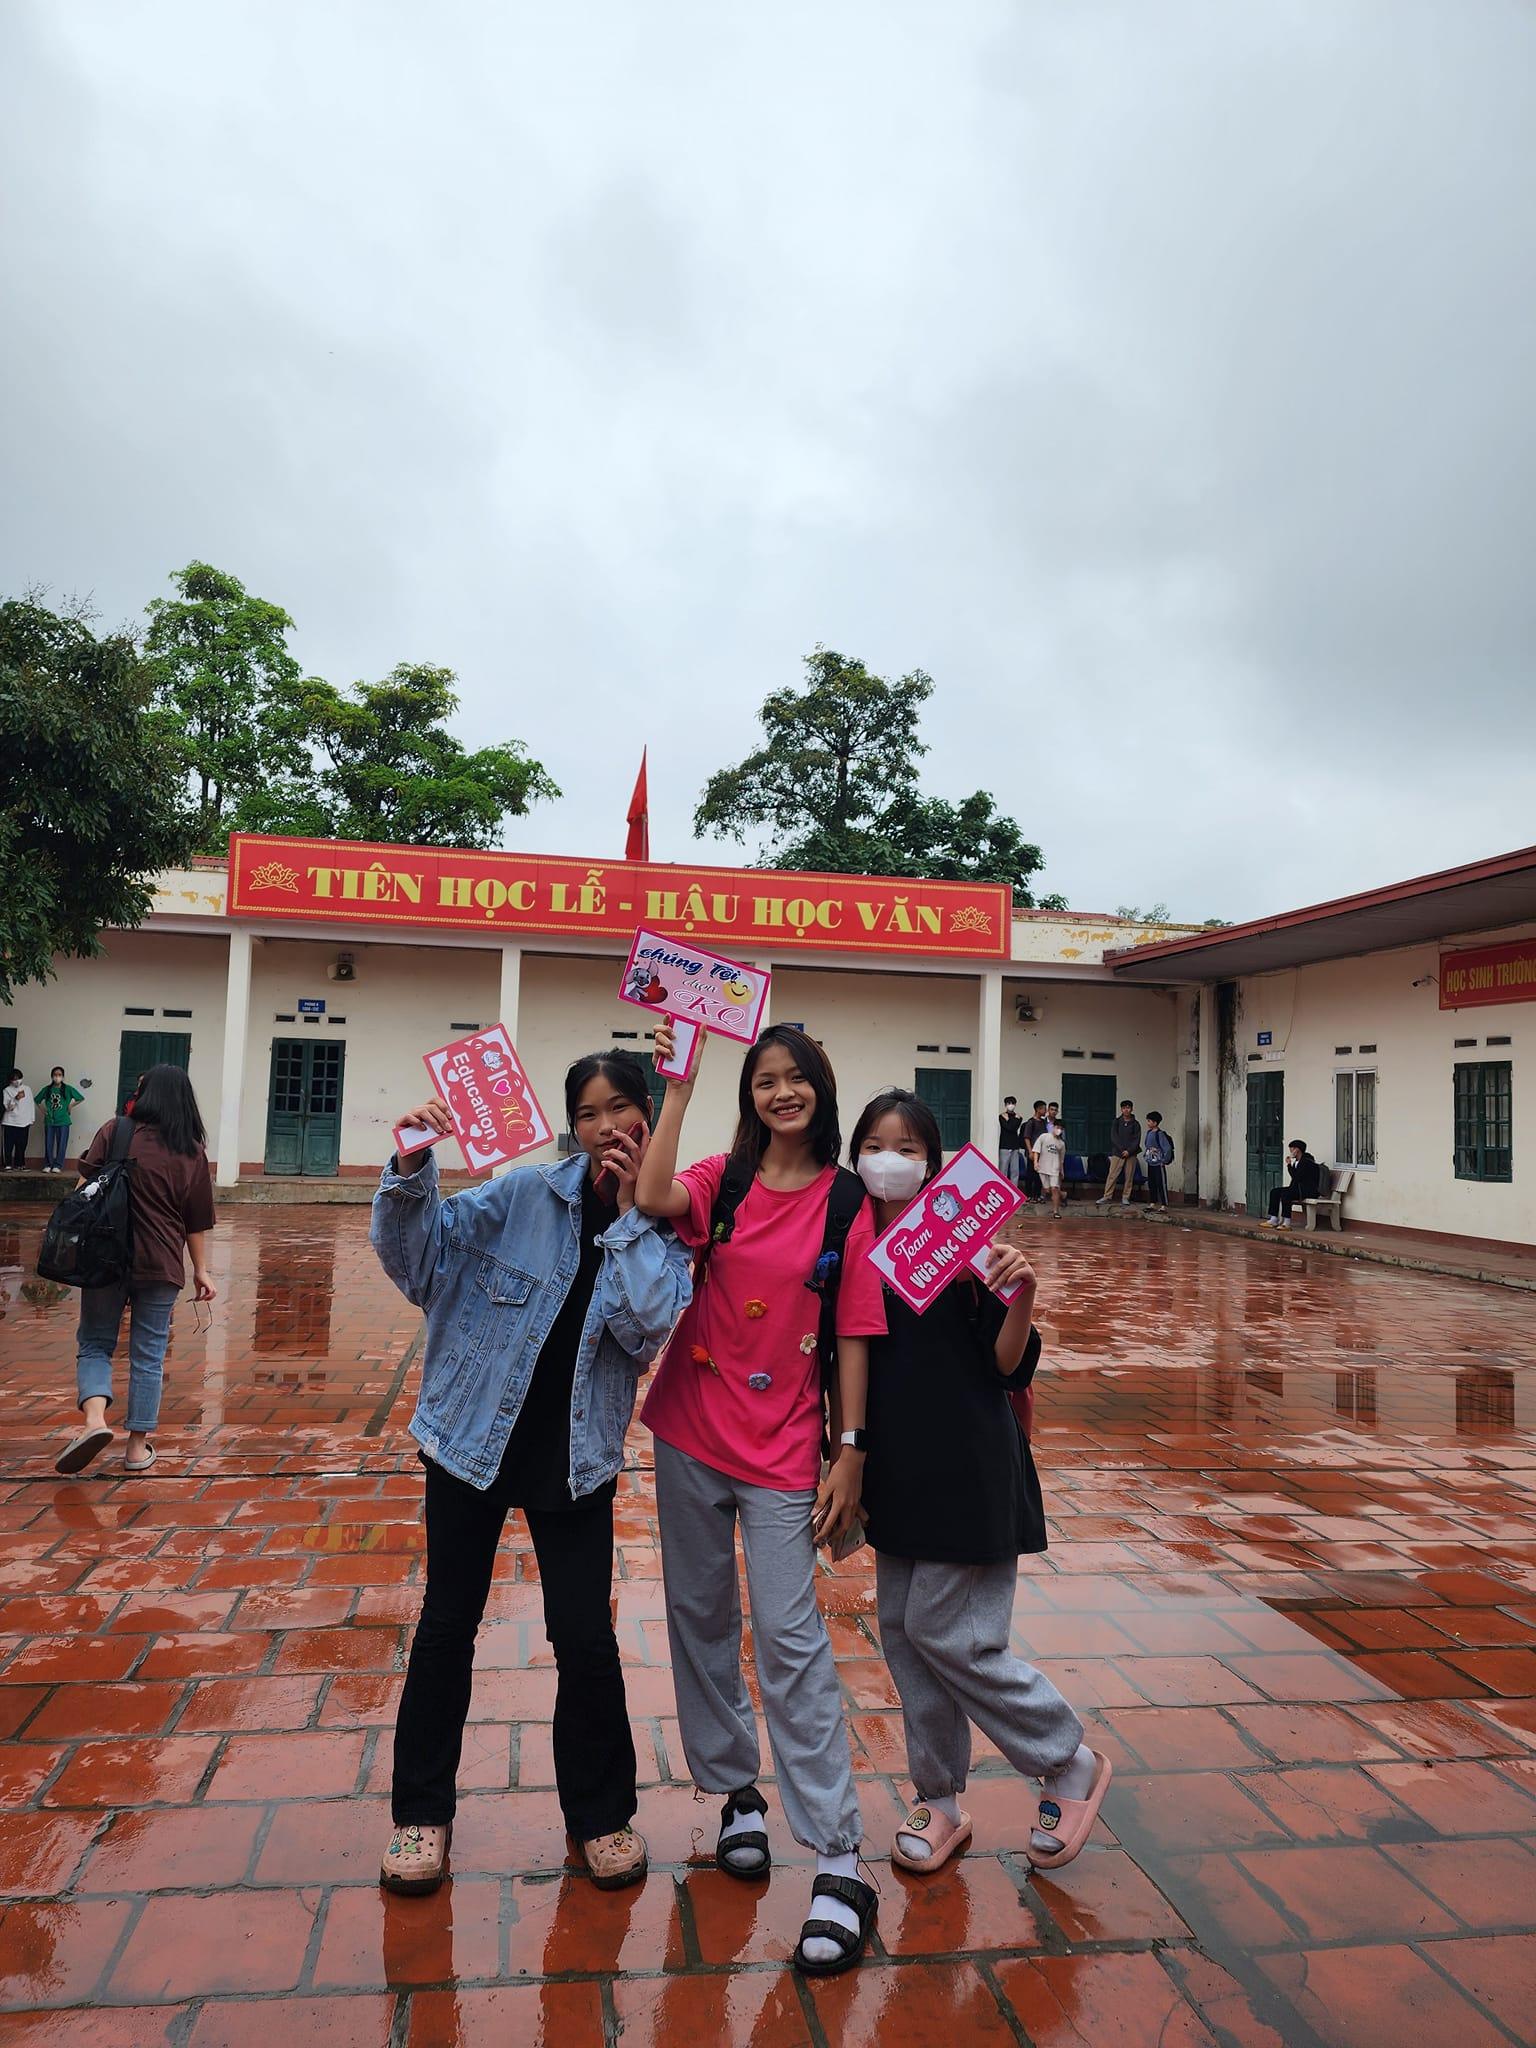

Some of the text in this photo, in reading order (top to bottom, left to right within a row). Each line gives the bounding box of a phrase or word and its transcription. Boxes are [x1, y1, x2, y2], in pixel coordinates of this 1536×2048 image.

[307, 862, 424, 904] TIÊN
[437, 876, 536, 919] HỌC
[549, 869, 606, 915] LỄ
[645, 883, 740, 931] HẬU
[752, 896, 843, 937] HỌC
[855, 895, 944, 934] VĂN
[1446, 969, 1466, 997] HỌC
[1469, 965, 1494, 990] SINH
[452, 1051, 498, 1141] Education
[487, 1069, 508, 1082] I
[893, 1228, 933, 1266] Team
[931, 1239, 960, 1267] Học
[974, 1188, 1005, 1221] Chơi
